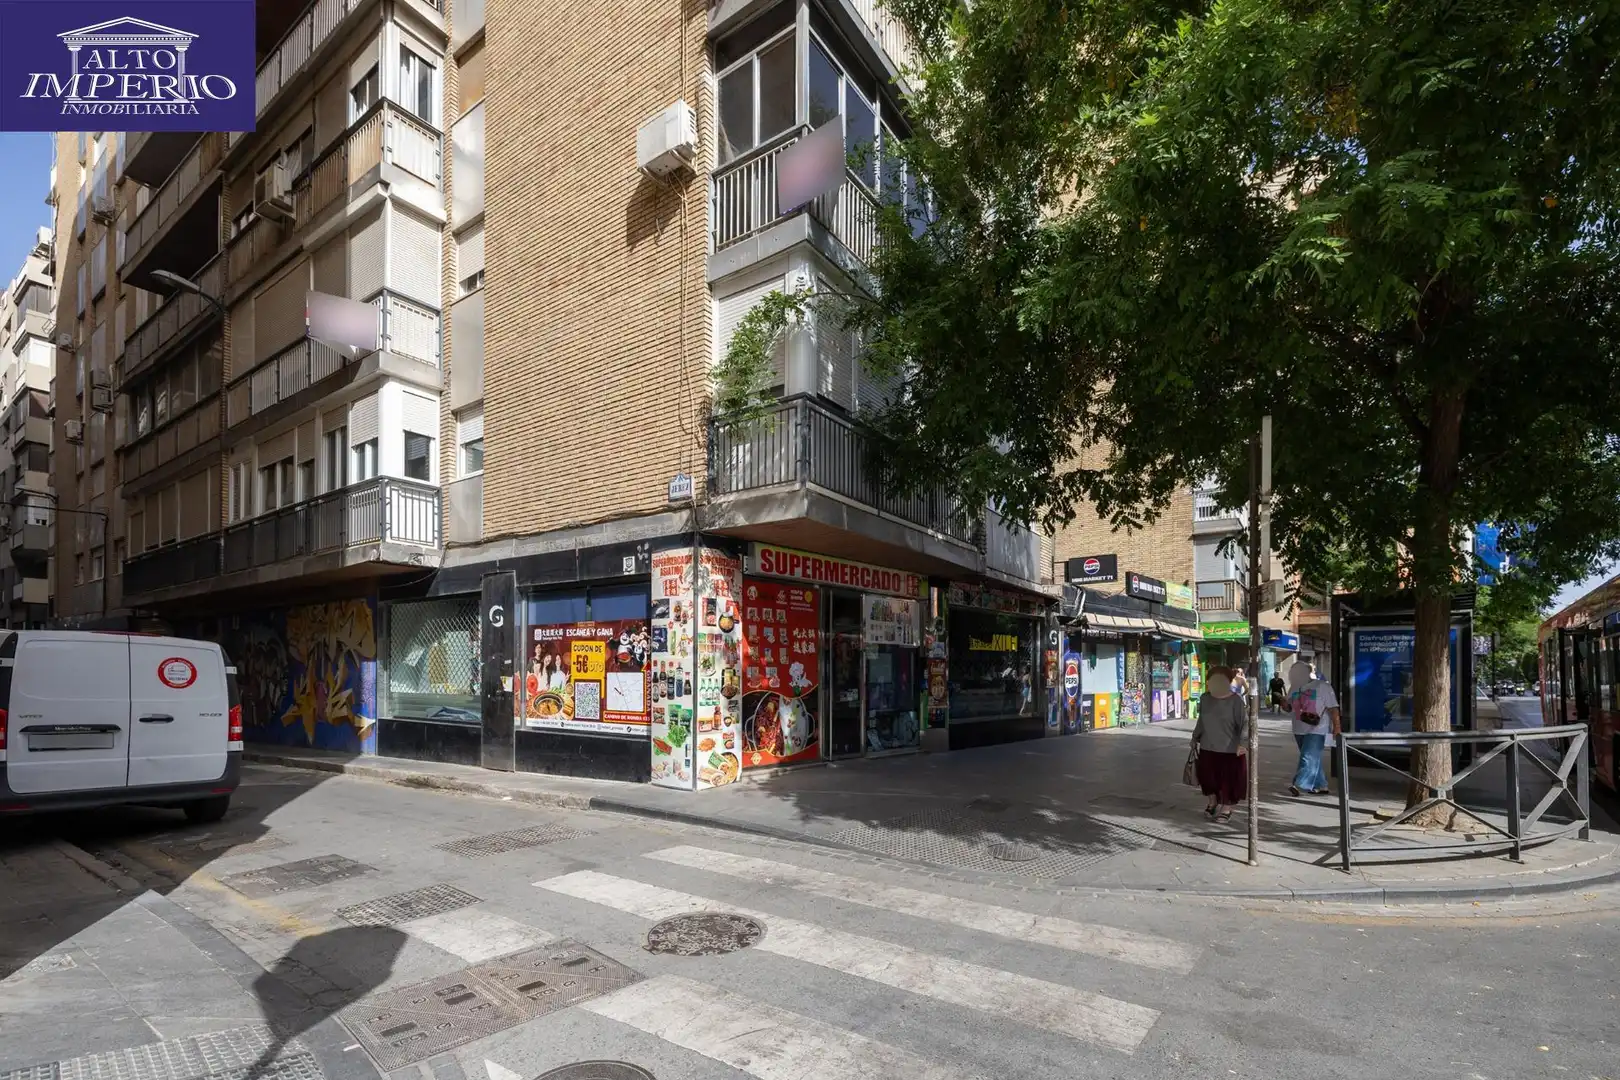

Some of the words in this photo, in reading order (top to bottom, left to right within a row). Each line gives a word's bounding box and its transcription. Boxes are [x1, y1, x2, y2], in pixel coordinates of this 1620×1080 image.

[760, 548, 901, 592] SUPERMERCADO
[596, 627, 613, 636] GANA
[595, 645, 602, 653] DE
